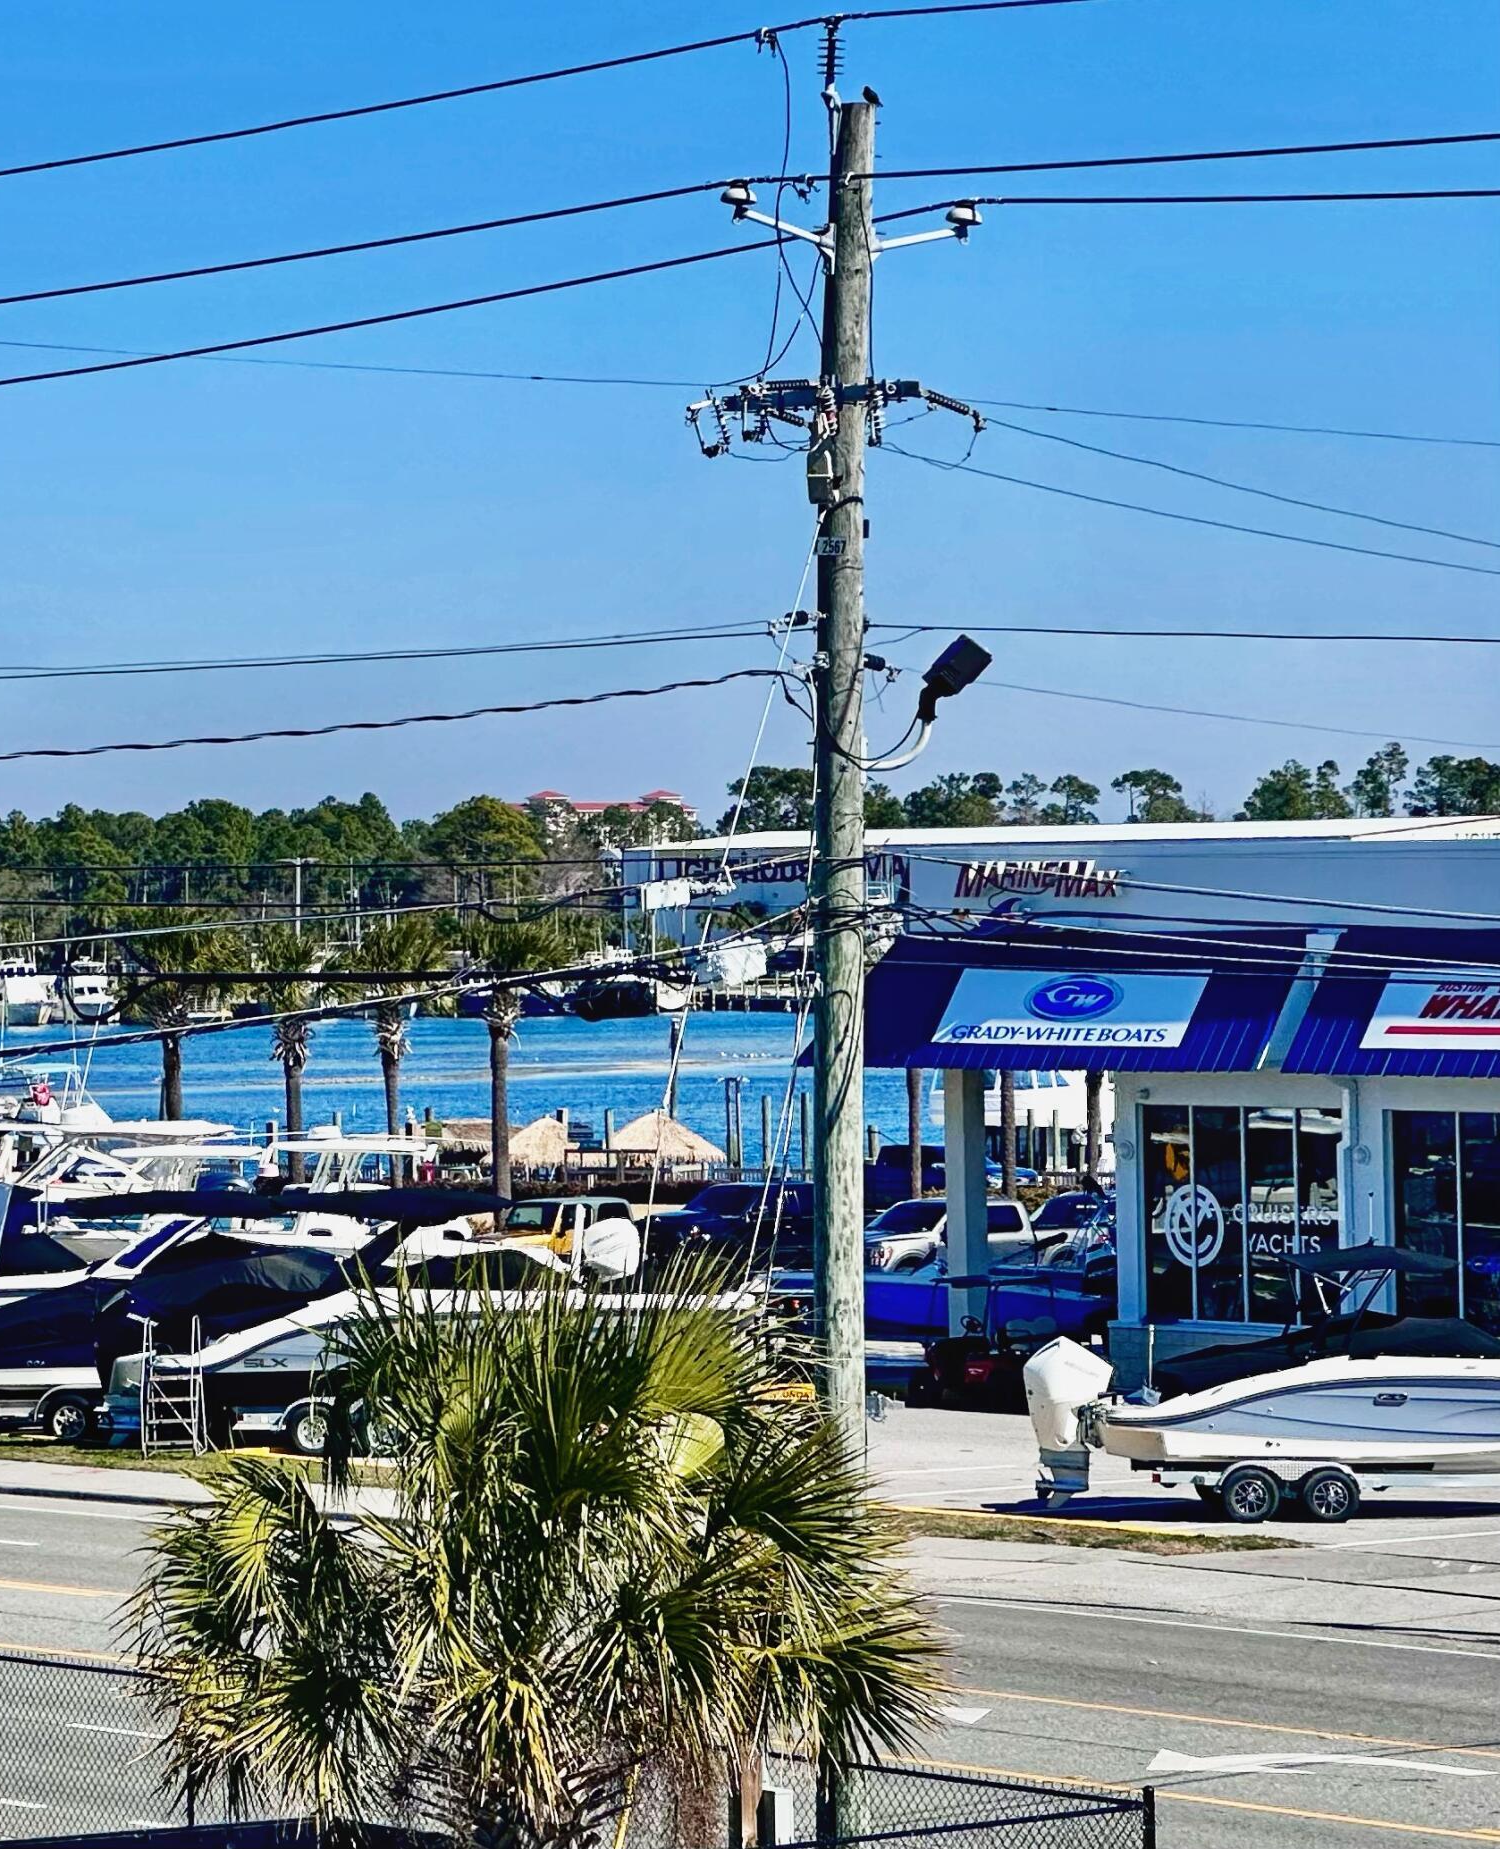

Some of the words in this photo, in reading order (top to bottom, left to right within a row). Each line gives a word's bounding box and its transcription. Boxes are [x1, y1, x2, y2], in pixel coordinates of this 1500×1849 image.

[823, 540, 847, 554] 2567
[1418, 994, 1500, 1019] WHA
[951, 1024, 1099, 1042] GRADY-WHITE
[1100, 1028, 1169, 1043] BOATS
[243, 1358, 288, 1368] SLX
